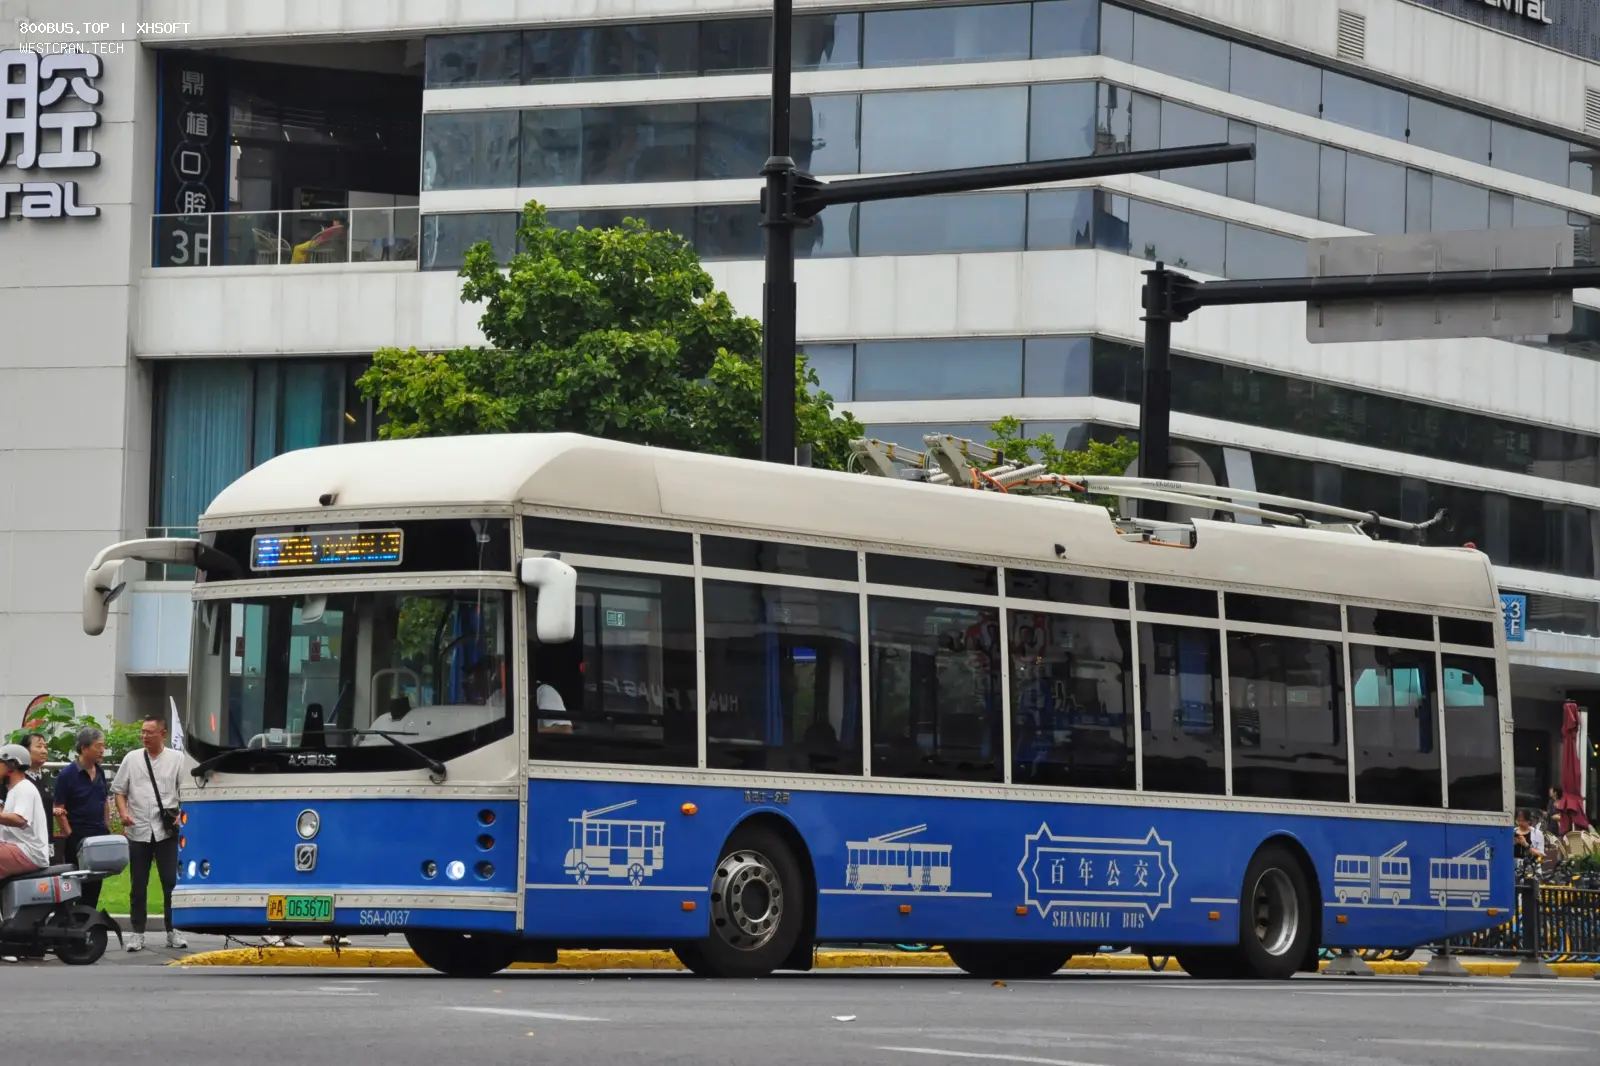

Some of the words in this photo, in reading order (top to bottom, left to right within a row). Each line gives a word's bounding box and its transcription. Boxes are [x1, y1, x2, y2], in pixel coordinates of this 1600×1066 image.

[170, 229, 210, 265] 3F
[1050, 857, 1149, 888] 百年公交
[359, 909, 411, 926] S5A-0037
[1052, 910, 1111, 928] SHANGHAI
[1122, 912, 1145, 929] BUS
